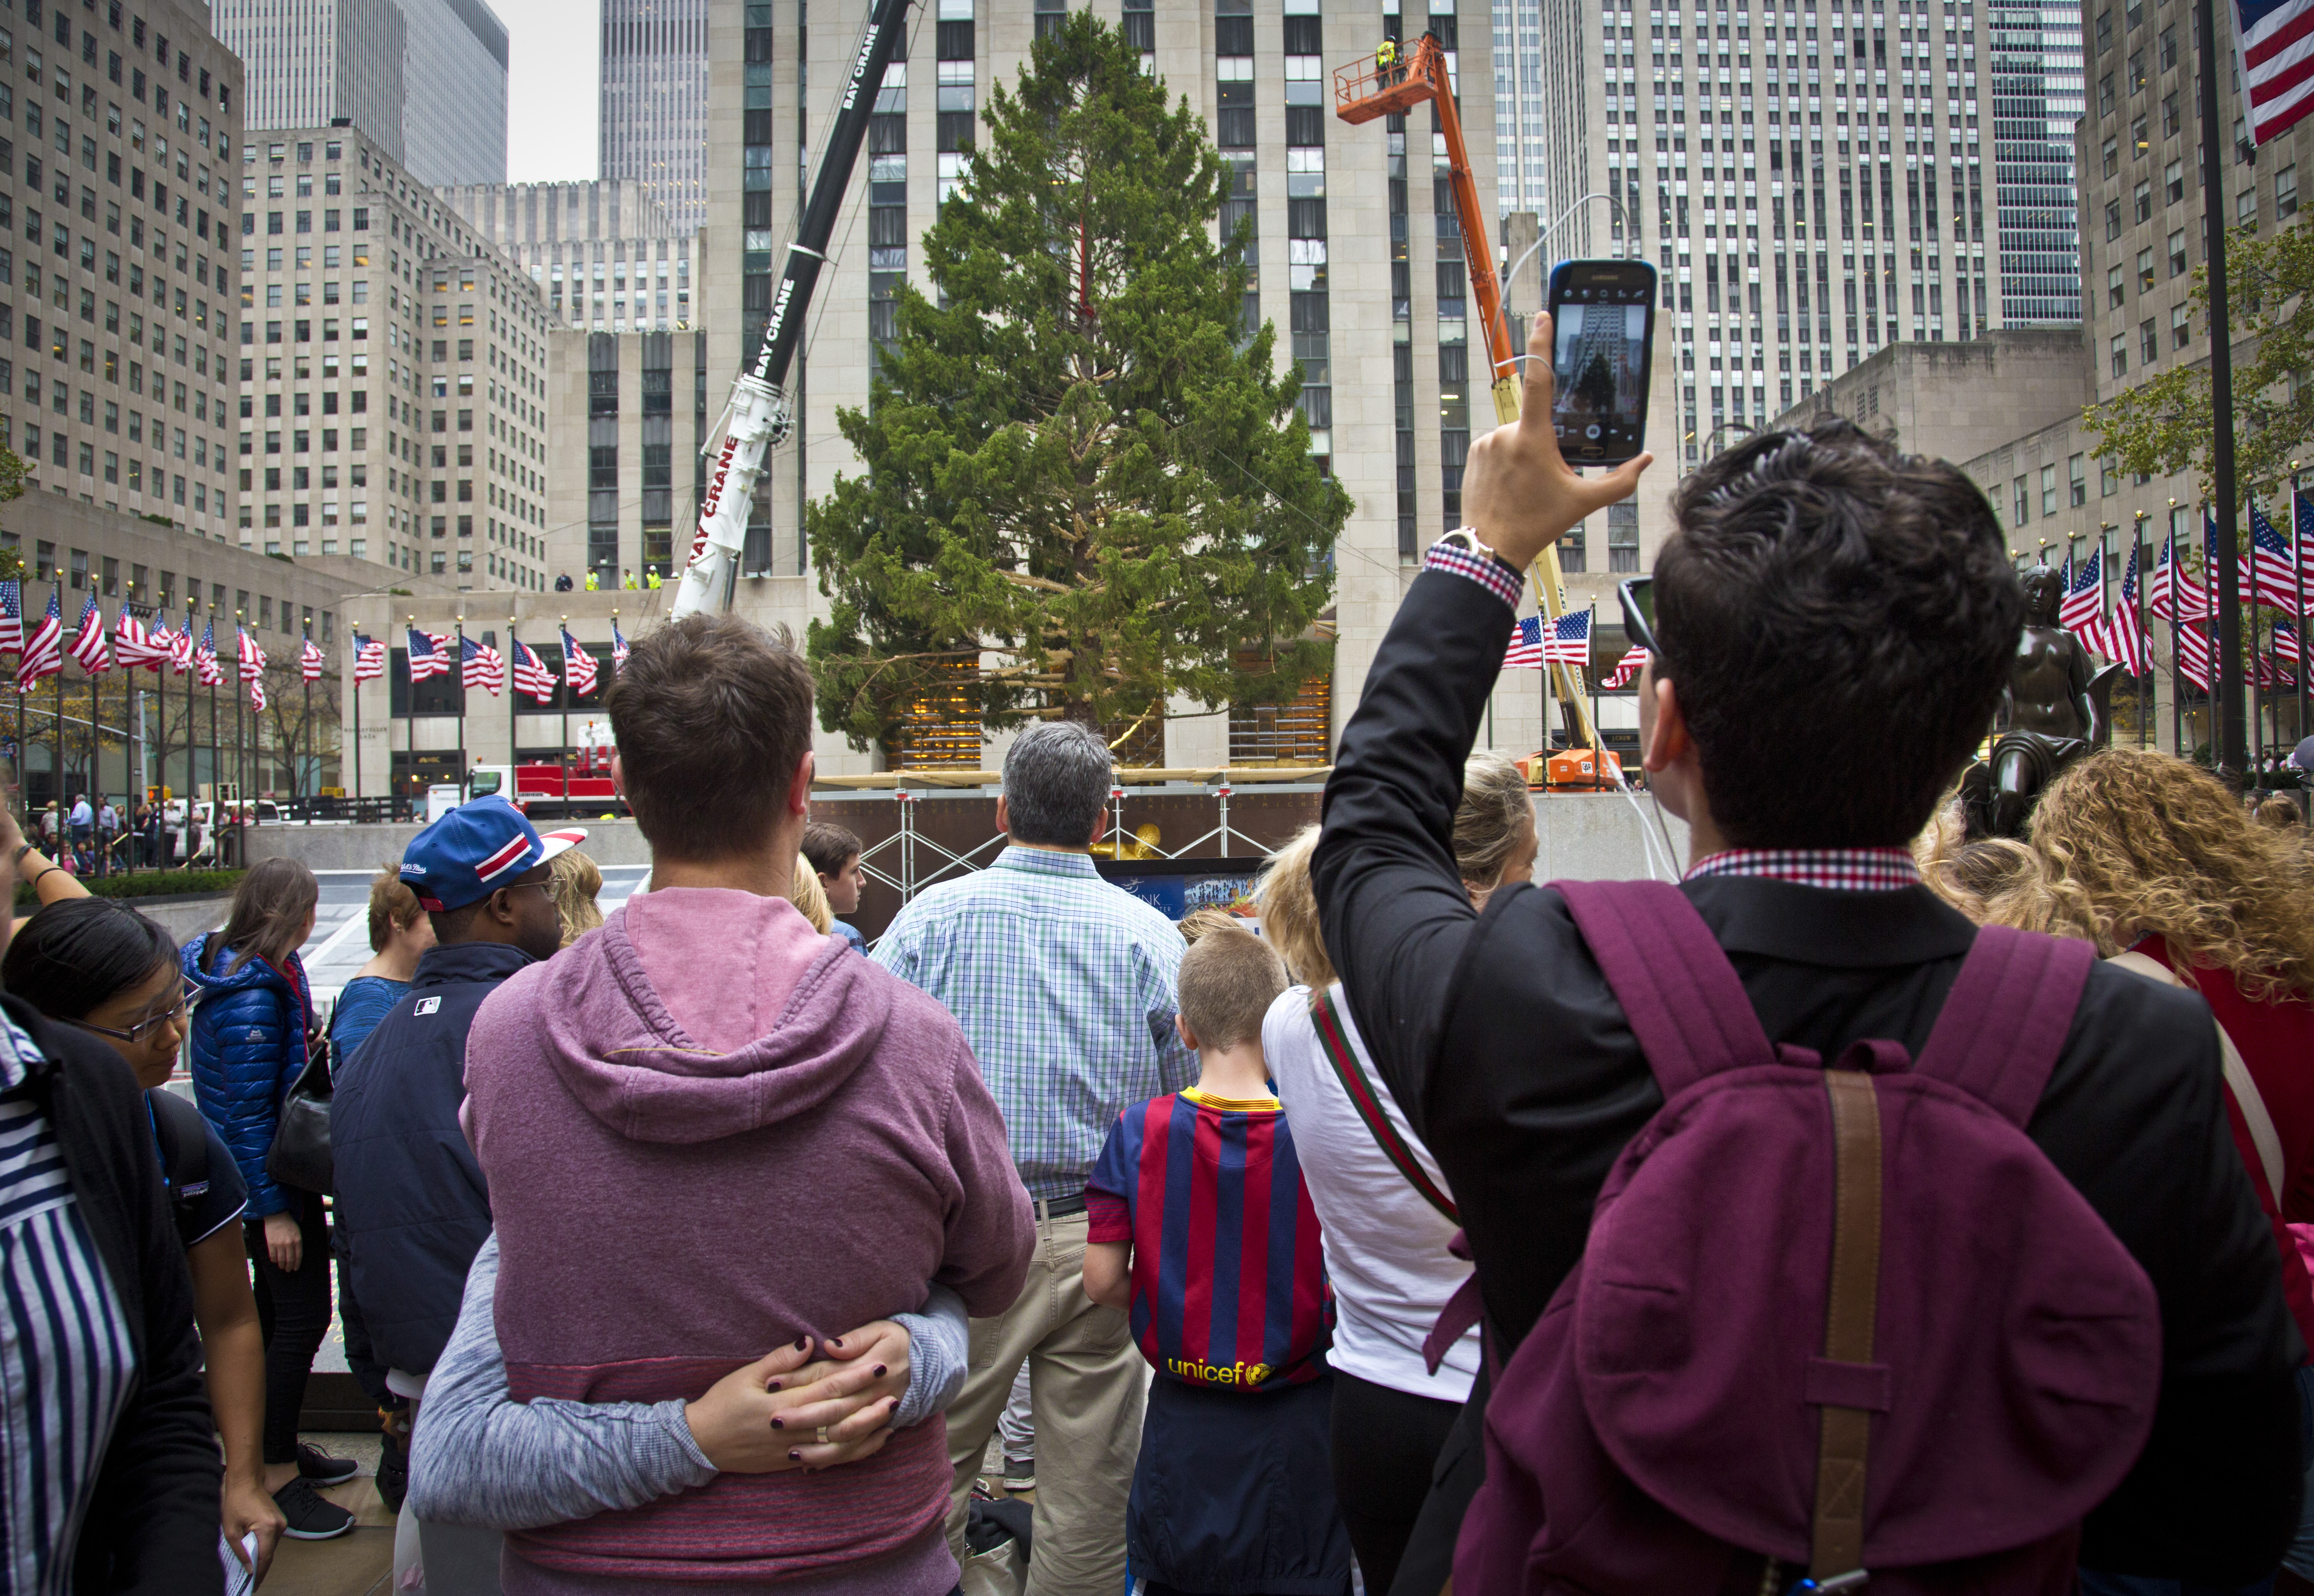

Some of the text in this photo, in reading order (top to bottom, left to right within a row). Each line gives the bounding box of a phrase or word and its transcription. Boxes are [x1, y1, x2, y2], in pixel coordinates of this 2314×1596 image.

[843, 24, 880, 110] BAY CRANE
[754, 278, 795, 378] BAY CRANE
[703, 434, 738, 518] CRANE
[1558, 584, 1567, 610] JLG
[1575, 664, 1584, 695] OOM
[1168, 1358, 1245, 1385] unicef
